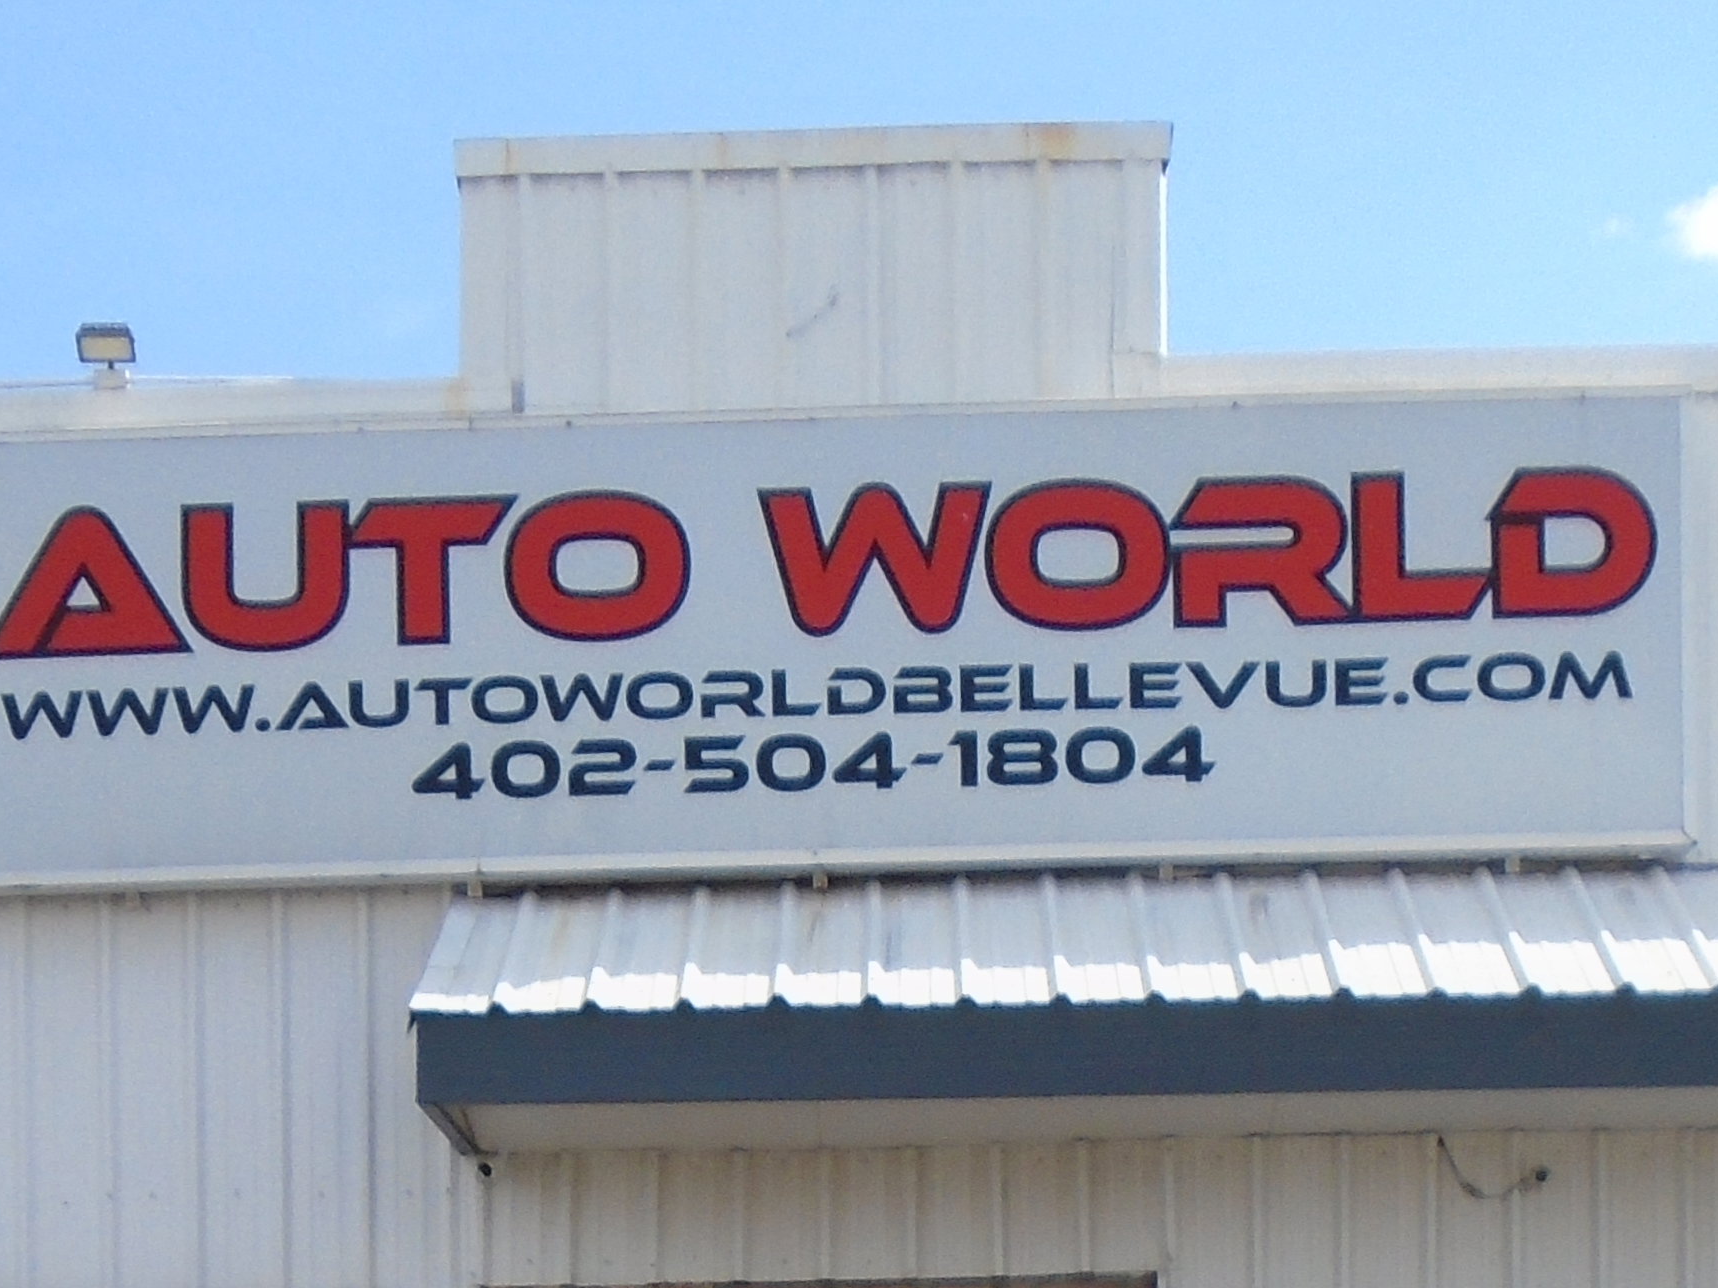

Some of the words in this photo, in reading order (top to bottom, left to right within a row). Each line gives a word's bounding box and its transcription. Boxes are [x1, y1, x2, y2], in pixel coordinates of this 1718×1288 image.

[757, 466, 1658, 638] WORLD
[0, 650, 1634, 741] WWW.AUTOWORLDBELLEVUE.COM
[411, 725, 1216, 800] 402-504-1804
